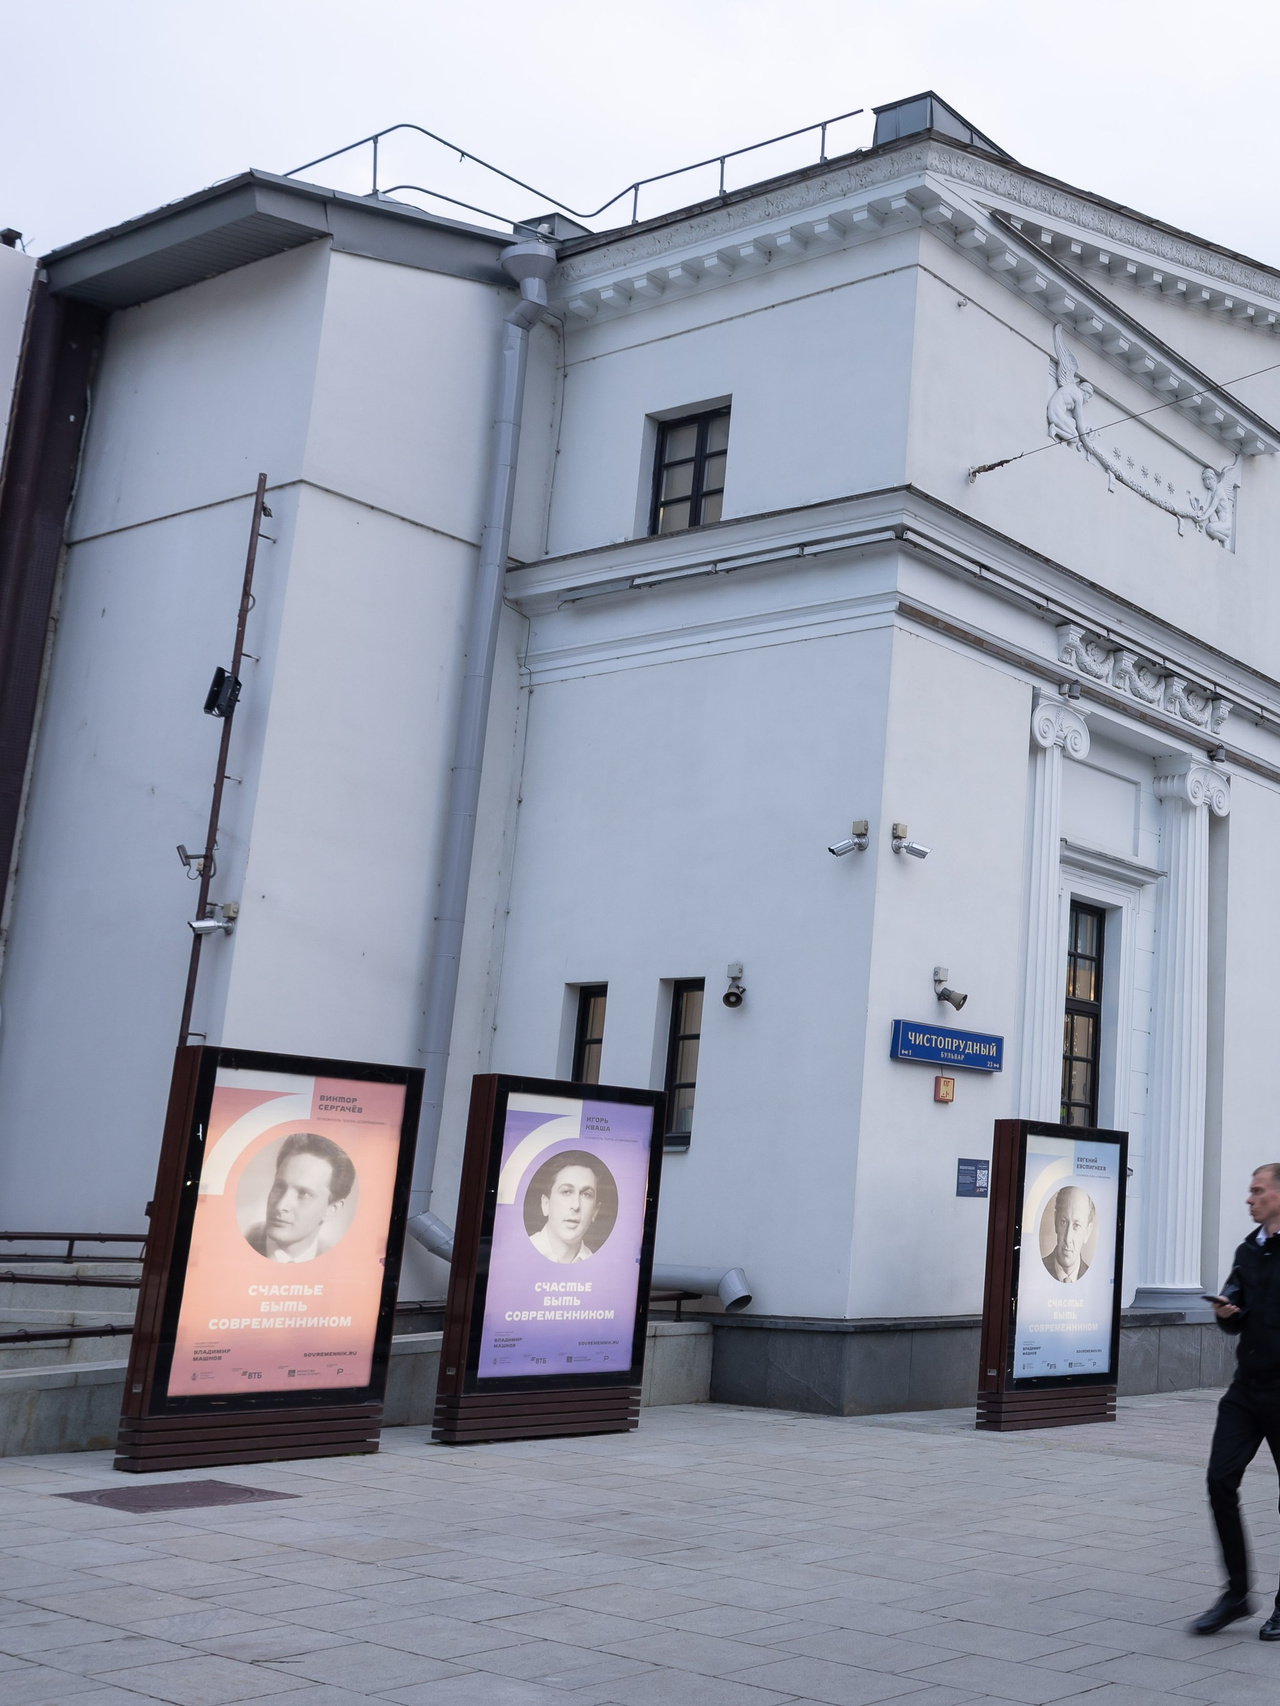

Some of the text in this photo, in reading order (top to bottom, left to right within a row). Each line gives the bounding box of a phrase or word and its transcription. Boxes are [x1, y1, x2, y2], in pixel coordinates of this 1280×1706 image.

[908, 1031, 997, 1057] ЧИСТОПРУДНЫЙ
[940, 1052, 965, 1060] БУЛЬВАР
[320, 1095, 357, 1104] ВИКТОР
[318, 1104, 363, 1113] СЕРГАЧЁВ
[248, 1284, 323, 1296] СЧАСТЬЕ
[534, 1282, 593, 1292] СЧАСТЬЕ
[543, 1296, 581, 1306] БЫТЬ
[1047, 1299, 1084, 1308] СЧАСТЬЕ
[260, 1301, 307, 1312] БЫТЬ
[504, 1310, 615, 1321] СОВРЕМЕННИКОМ
[1053, 1311, 1078, 1320] БЫТЬ
[208, 1316, 352, 1330] СОВРЕМЕННИКОМ
[1028, 1322, 1098, 1333] СОВРЕМЕННИКОМ
